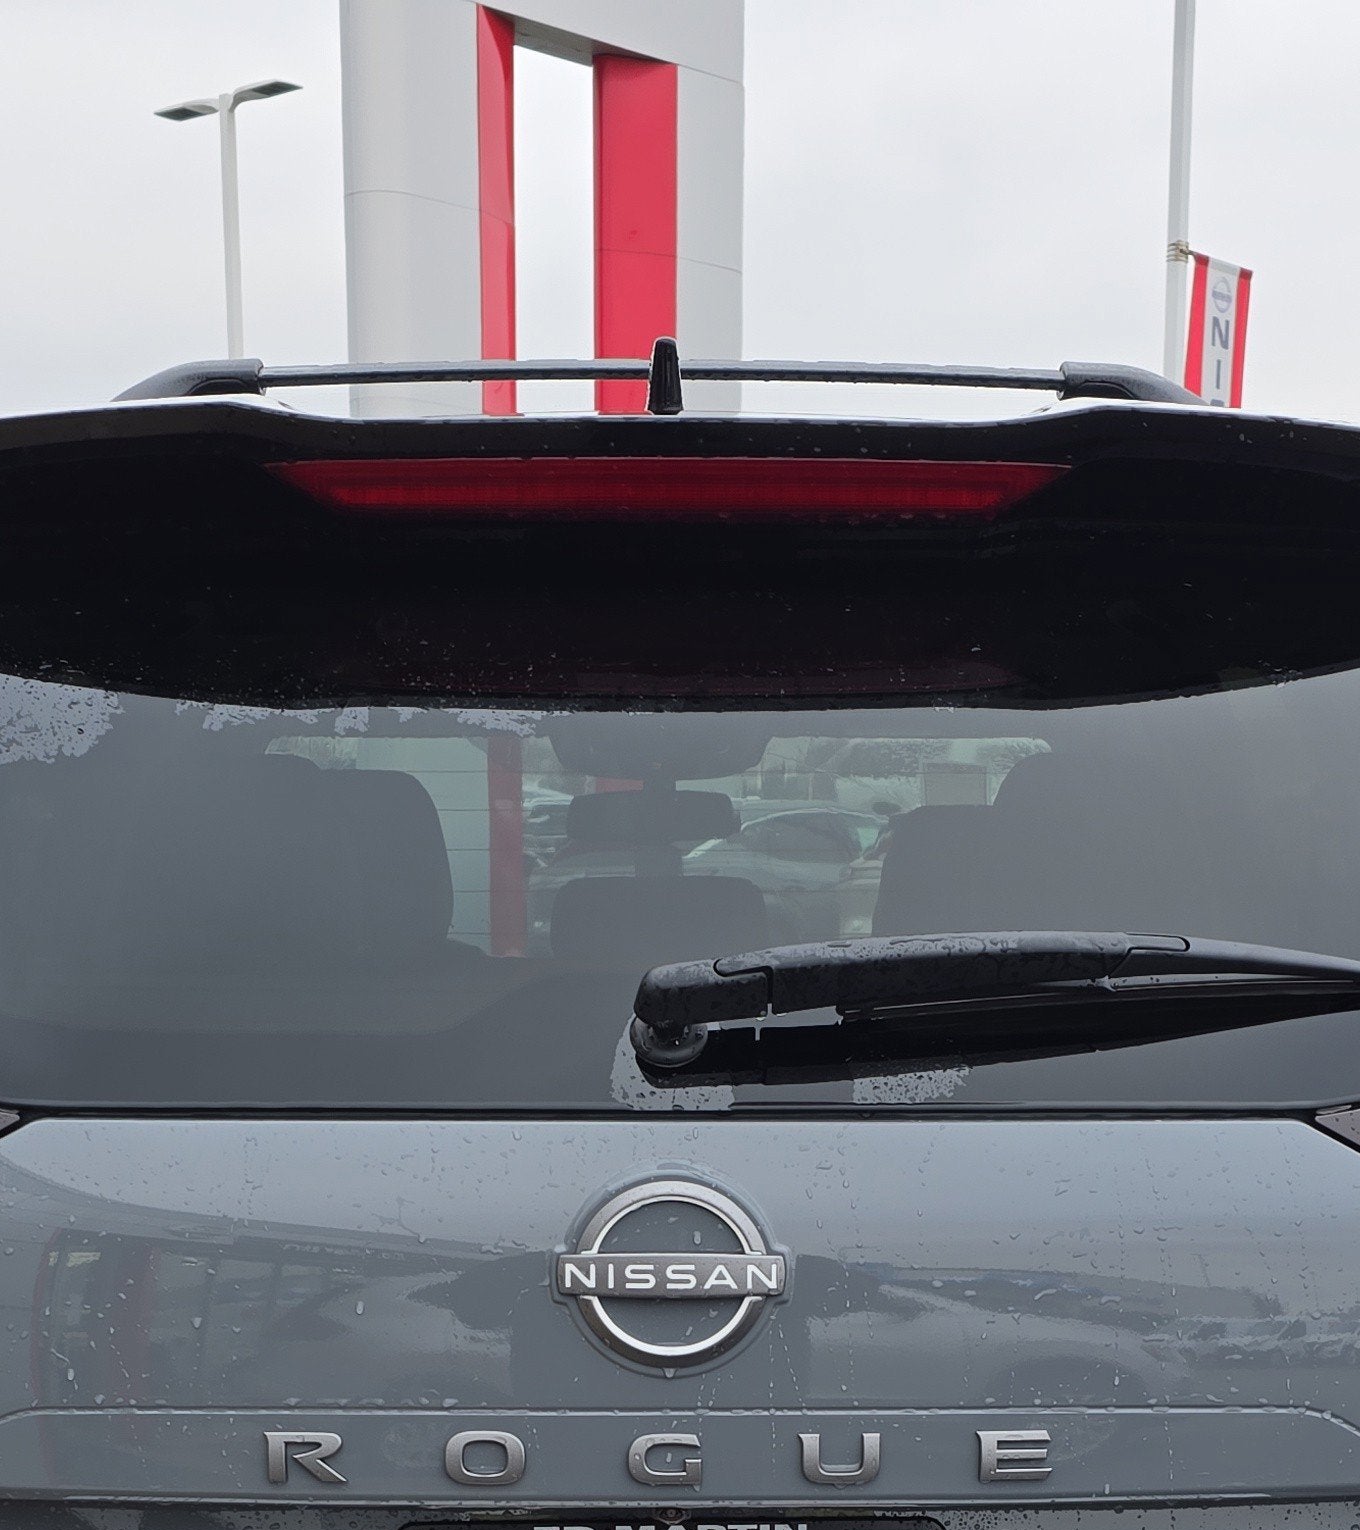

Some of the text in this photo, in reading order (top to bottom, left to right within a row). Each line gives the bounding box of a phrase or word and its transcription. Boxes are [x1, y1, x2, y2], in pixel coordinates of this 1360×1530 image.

[1210, 316, 1230, 406] NI
[564, 1262, 779, 1292] NISSAN
[263, 1429, 1055, 1488] ROGUE
